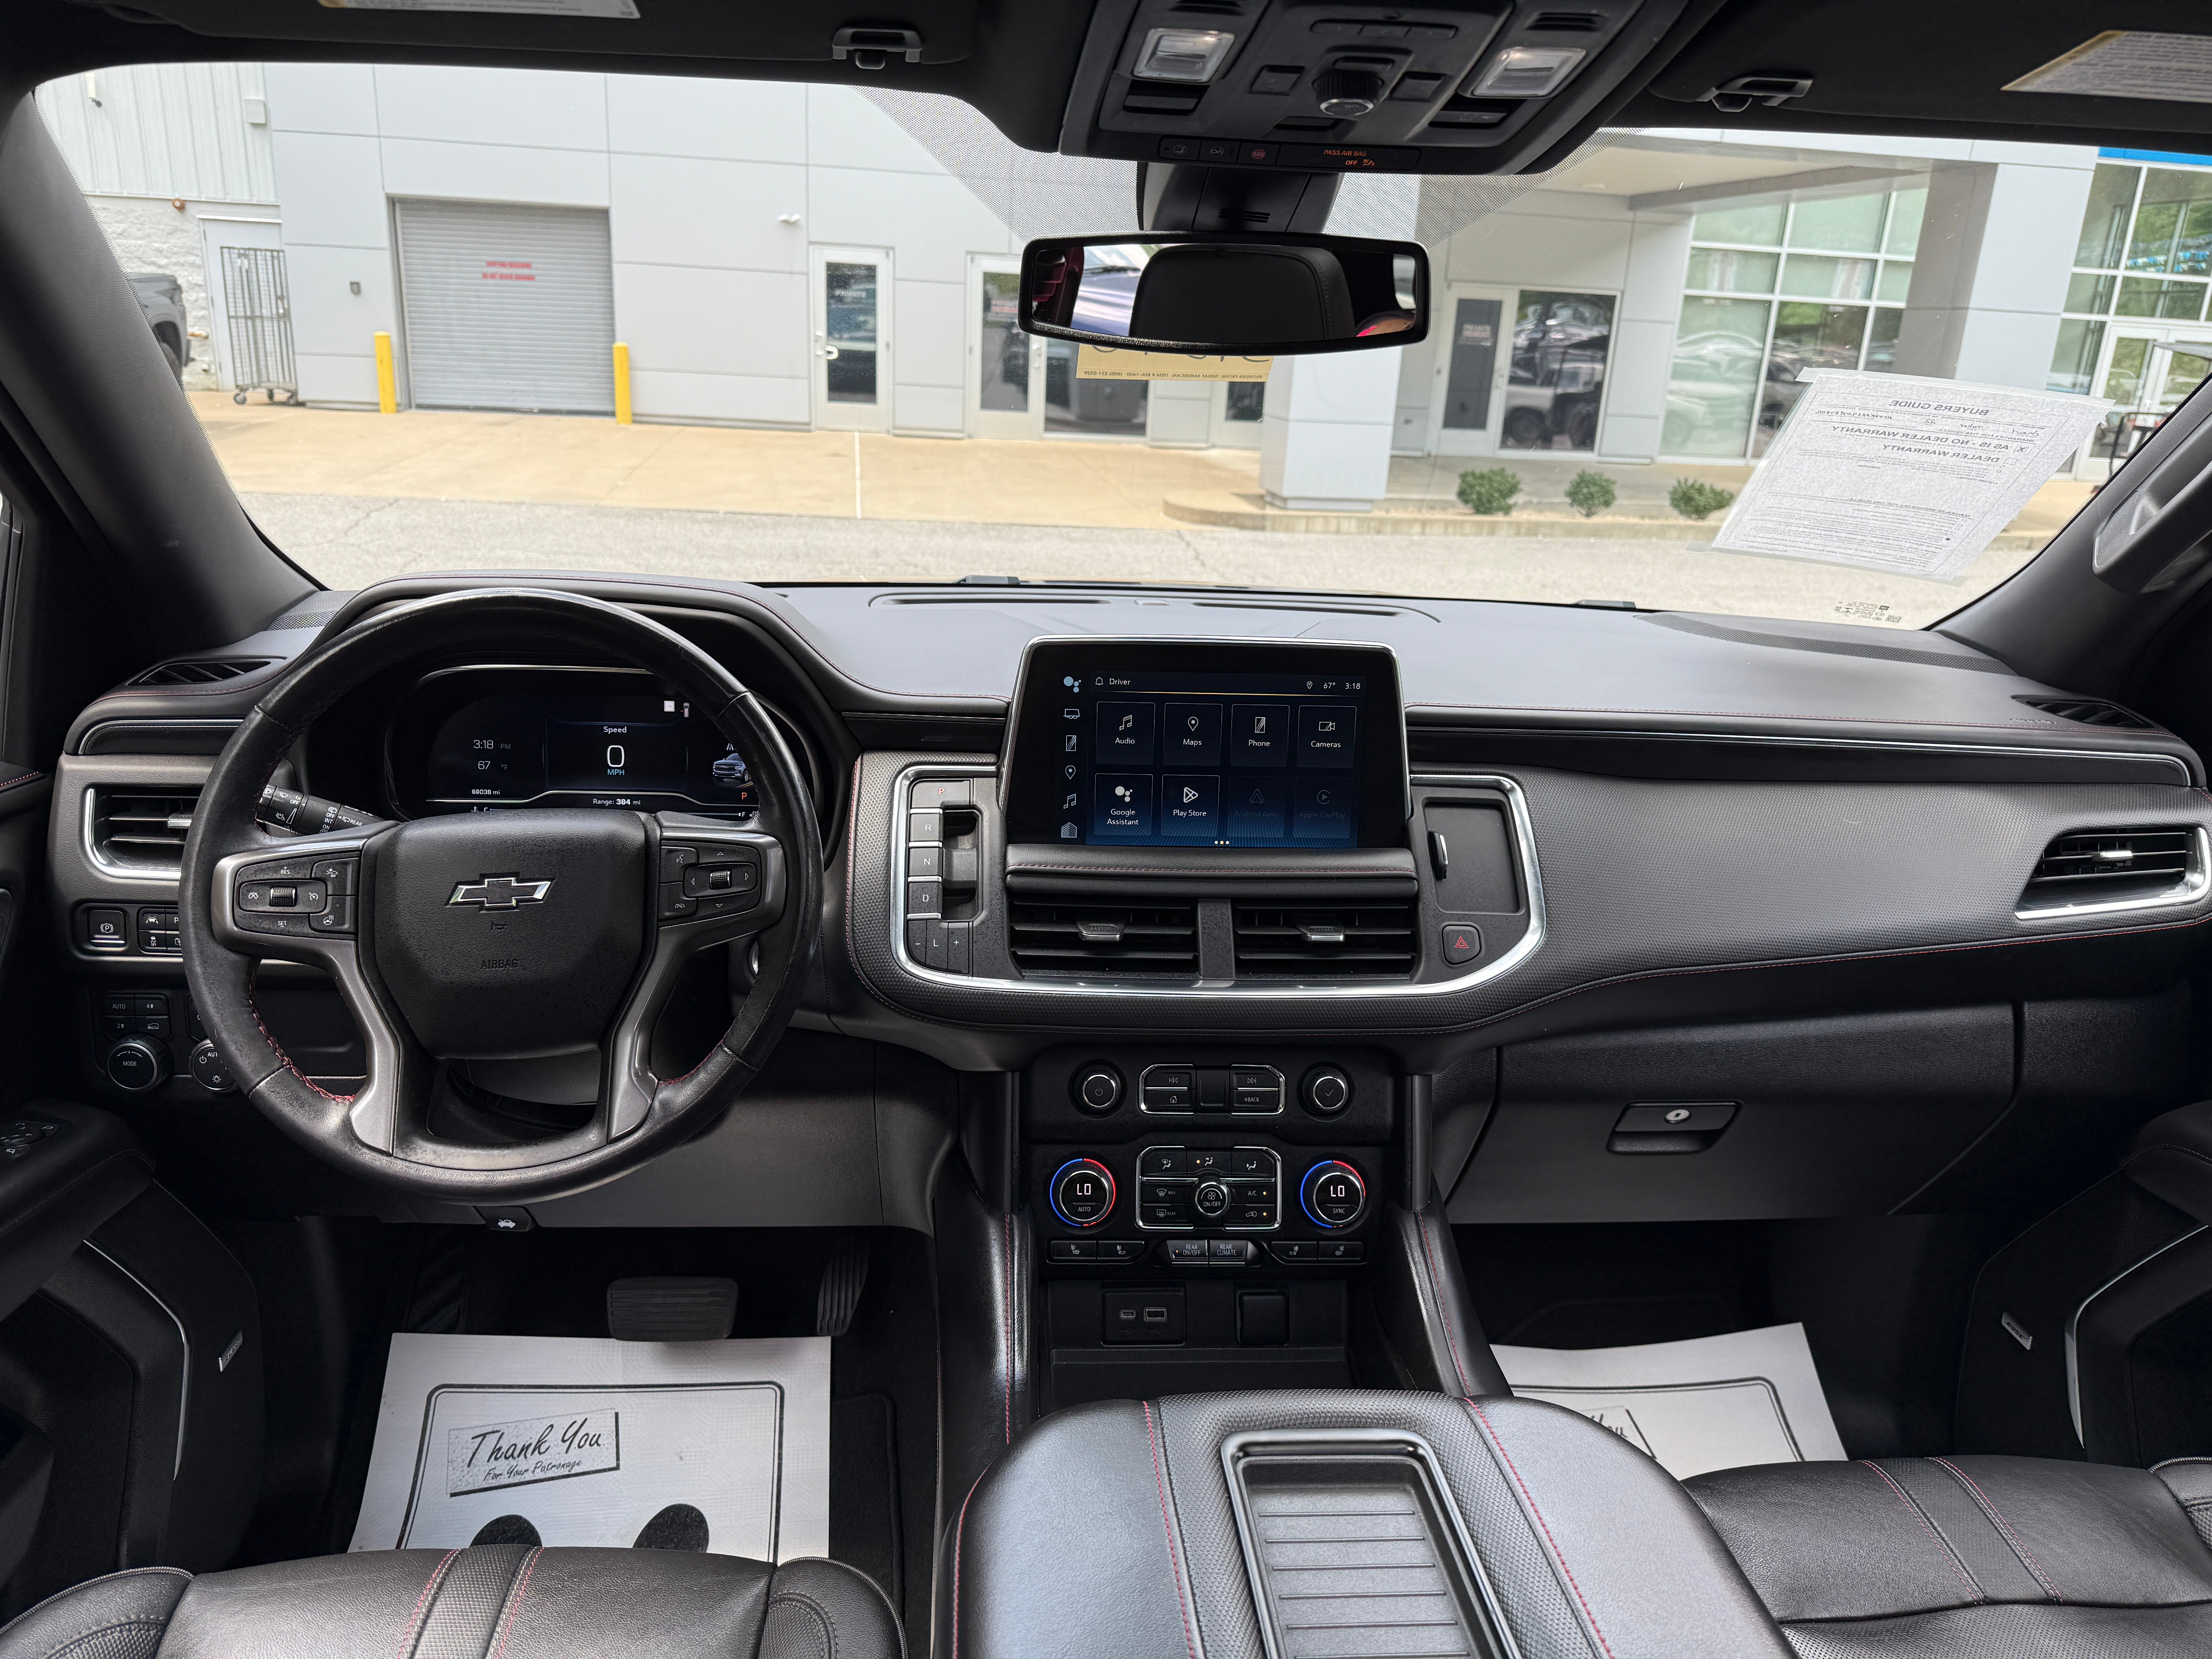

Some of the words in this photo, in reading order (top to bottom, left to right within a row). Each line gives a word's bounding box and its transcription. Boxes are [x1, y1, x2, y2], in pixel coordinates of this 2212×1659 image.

[1109, 678, 1130, 687] Driver
[1323, 682, 1336, 690] 67°
[1345, 682, 1361, 690] 3:18
[603, 726, 627, 735] Speed
[473, 739, 494, 750] 3:18
[1115, 737, 1135, 745] Audio
[1183, 738, 1202, 747] Maps
[1248, 739, 1271, 748] Phone
[1311, 740, 1341, 749] Cameras
[607, 745, 625, 768] 0
[477, 760, 491, 770] 67
[593, 798, 615, 807] Range:
[1110, 808, 1135, 818] Google
[1173, 809, 1186, 818] Play
[1299, 811, 1317, 820] Apple
[1319, 811, 1346, 820] CarPlay
[1107, 818, 1139, 826] Assistant
[922, 894, 929, 902] D
[933, 939, 938, 947] L
[481, 958, 519, 970] AIRBAG
[1077, 1183, 1091, 1195] LO
[1331, 1185, 1345, 1197] LO
[467, 1424, 554, 1468] Thank
[560, 1417, 602, 1455] You
[484, 1467, 502, 1482] For
[507, 1463, 529, 1479] Your
[533, 1459, 582, 1475] Patronage
